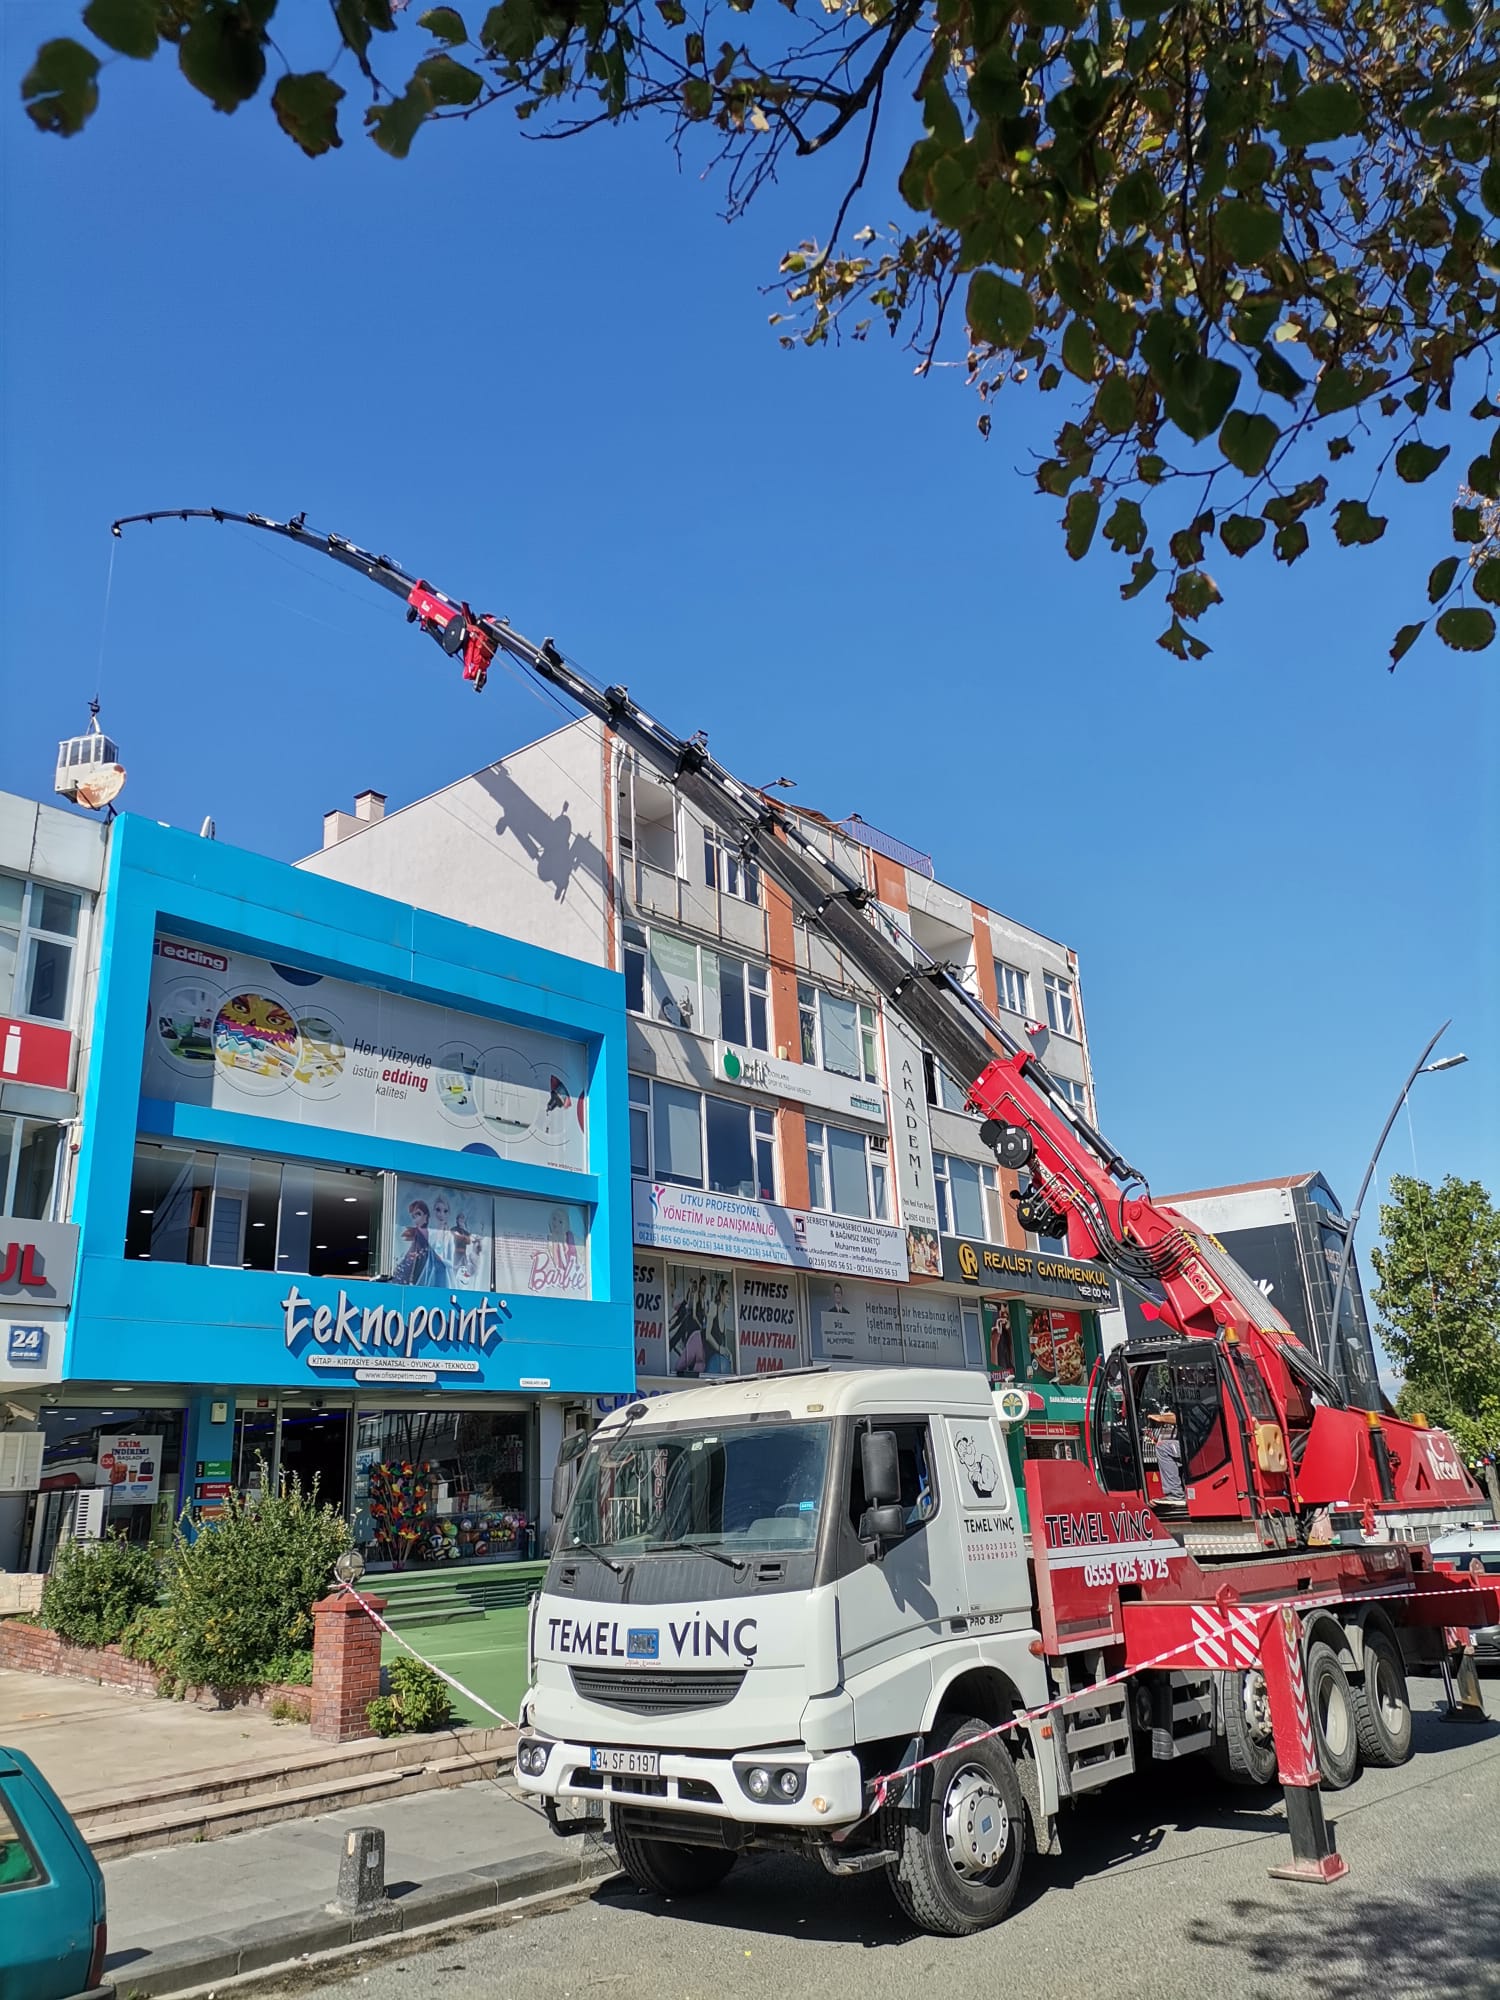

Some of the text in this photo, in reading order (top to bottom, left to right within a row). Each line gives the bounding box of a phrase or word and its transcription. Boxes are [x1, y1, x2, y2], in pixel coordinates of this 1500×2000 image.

[164, 945, 225, 970] edding
[353, 1037, 432, 1069] Her yüzeyde
[352, 1064, 428, 1093] üstün edding
[376, 1084, 407, 1100] kalitesi
[902, 1059, 921, 1189] AKADEMİ
[681, 1193, 760, 1218] UTKU PROFESYONEL
[663, 1205, 703, 1225] YÖNETİM
[705, 1217, 715, 1226] ve
[717, 1217, 777, 1237] DANIŞMANLIĞI
[806, 1216, 828, 1228] SERBEST
[834, 1241, 861, 1253] Muharrem
[529, 1250, 587, 1291] Barbie
[808, 1257, 827, 1268] 0(216)
[983, 1251, 1109, 1286] REALİST GAYRİMENKUL
[743, 1279, 788, 1299] FITNESS
[281, 1285, 498, 1358] teknopoint
[739, 1304, 795, 1325] KICKBOKS
[866, 1302, 898, 1319] Herhang
[12, 1330, 40, 1349] 24
[740, 1330, 796, 1349] MUAYTHAI
[312, 1356, 332, 1366] KİTAP
[374, 1359, 406, 1369] SANATSAL
[410, 1360, 440, 1370] OYUNCAK
[964, 1514, 1015, 1535] TEMEL VİNÇ
[1044, 1502, 1154, 1547] TEMEL VİNÇ
[1084, 1557, 1170, 1588] 0555 025 30 25
[969, 1616, 986, 1627] PRO
[548, 1610, 758, 1667] TEMEL VİNÇ
[596, 1751, 656, 1773] 34 SF 6197
